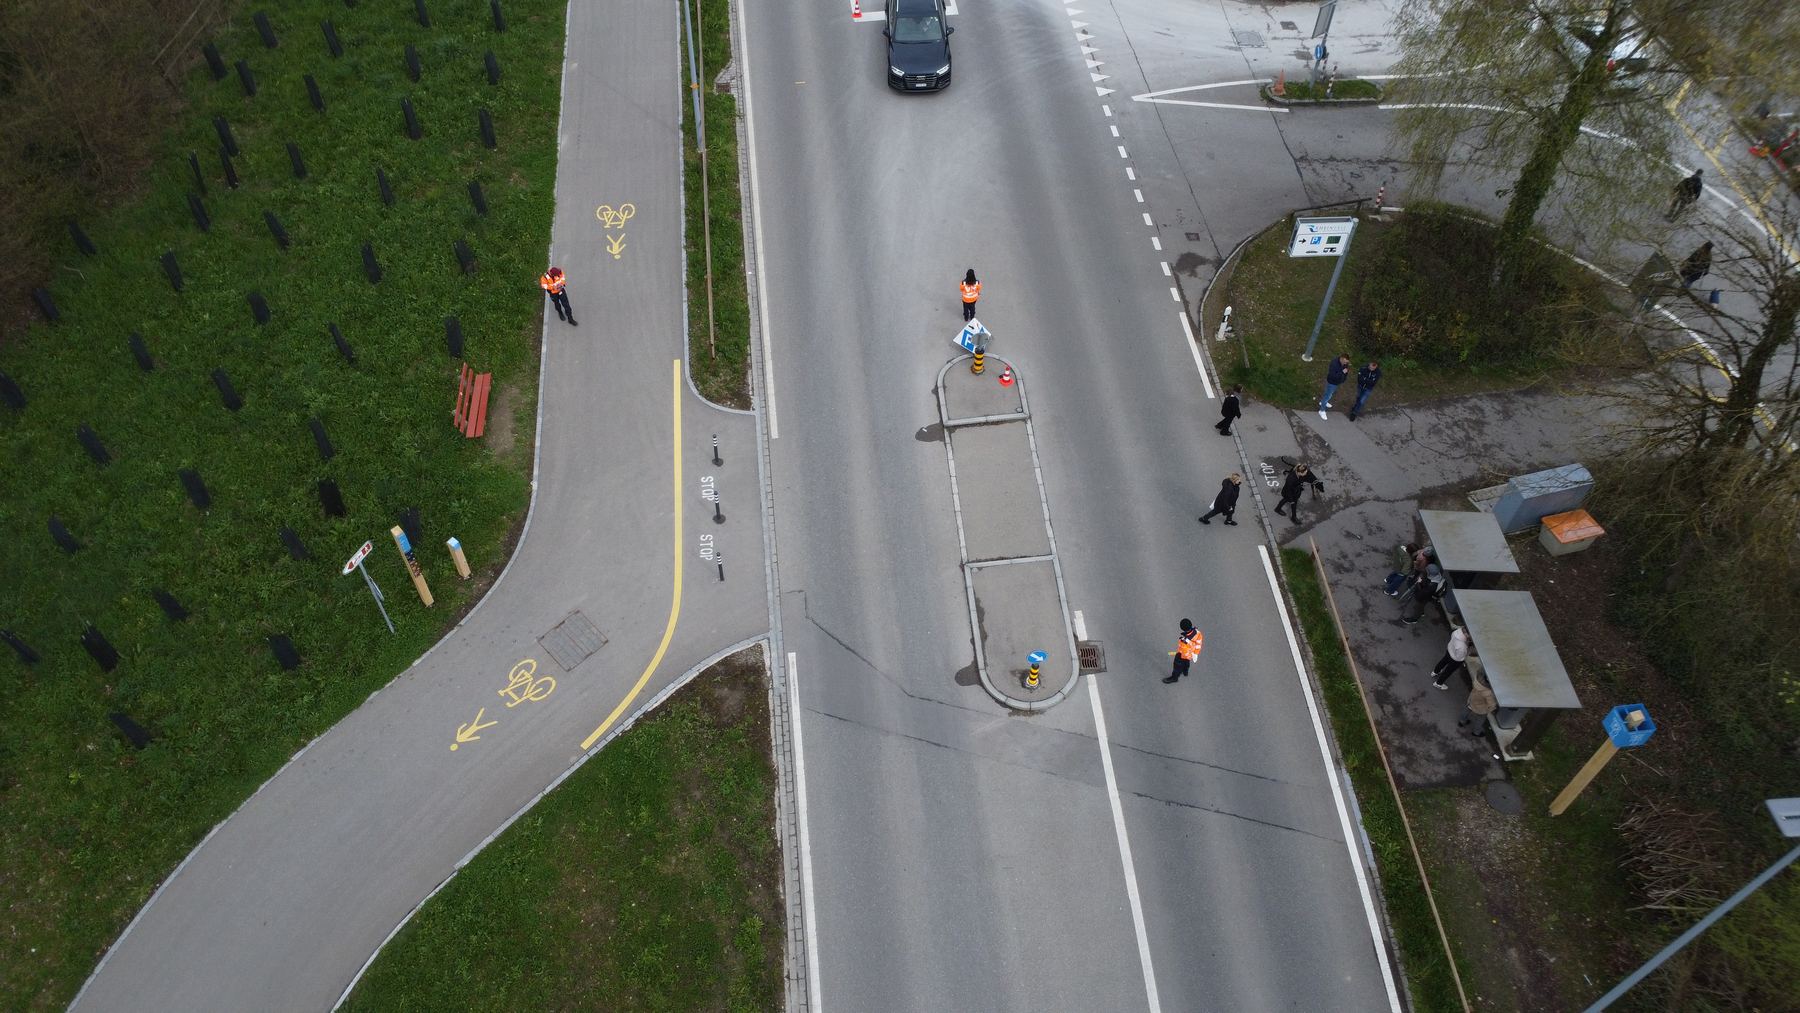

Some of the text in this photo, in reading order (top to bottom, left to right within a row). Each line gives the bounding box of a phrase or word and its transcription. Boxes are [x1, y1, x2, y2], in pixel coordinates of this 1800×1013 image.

[1260, 462, 1280, 487] STOP
[700, 476, 714, 501] STOP
[700, 534, 714, 561] STOP
